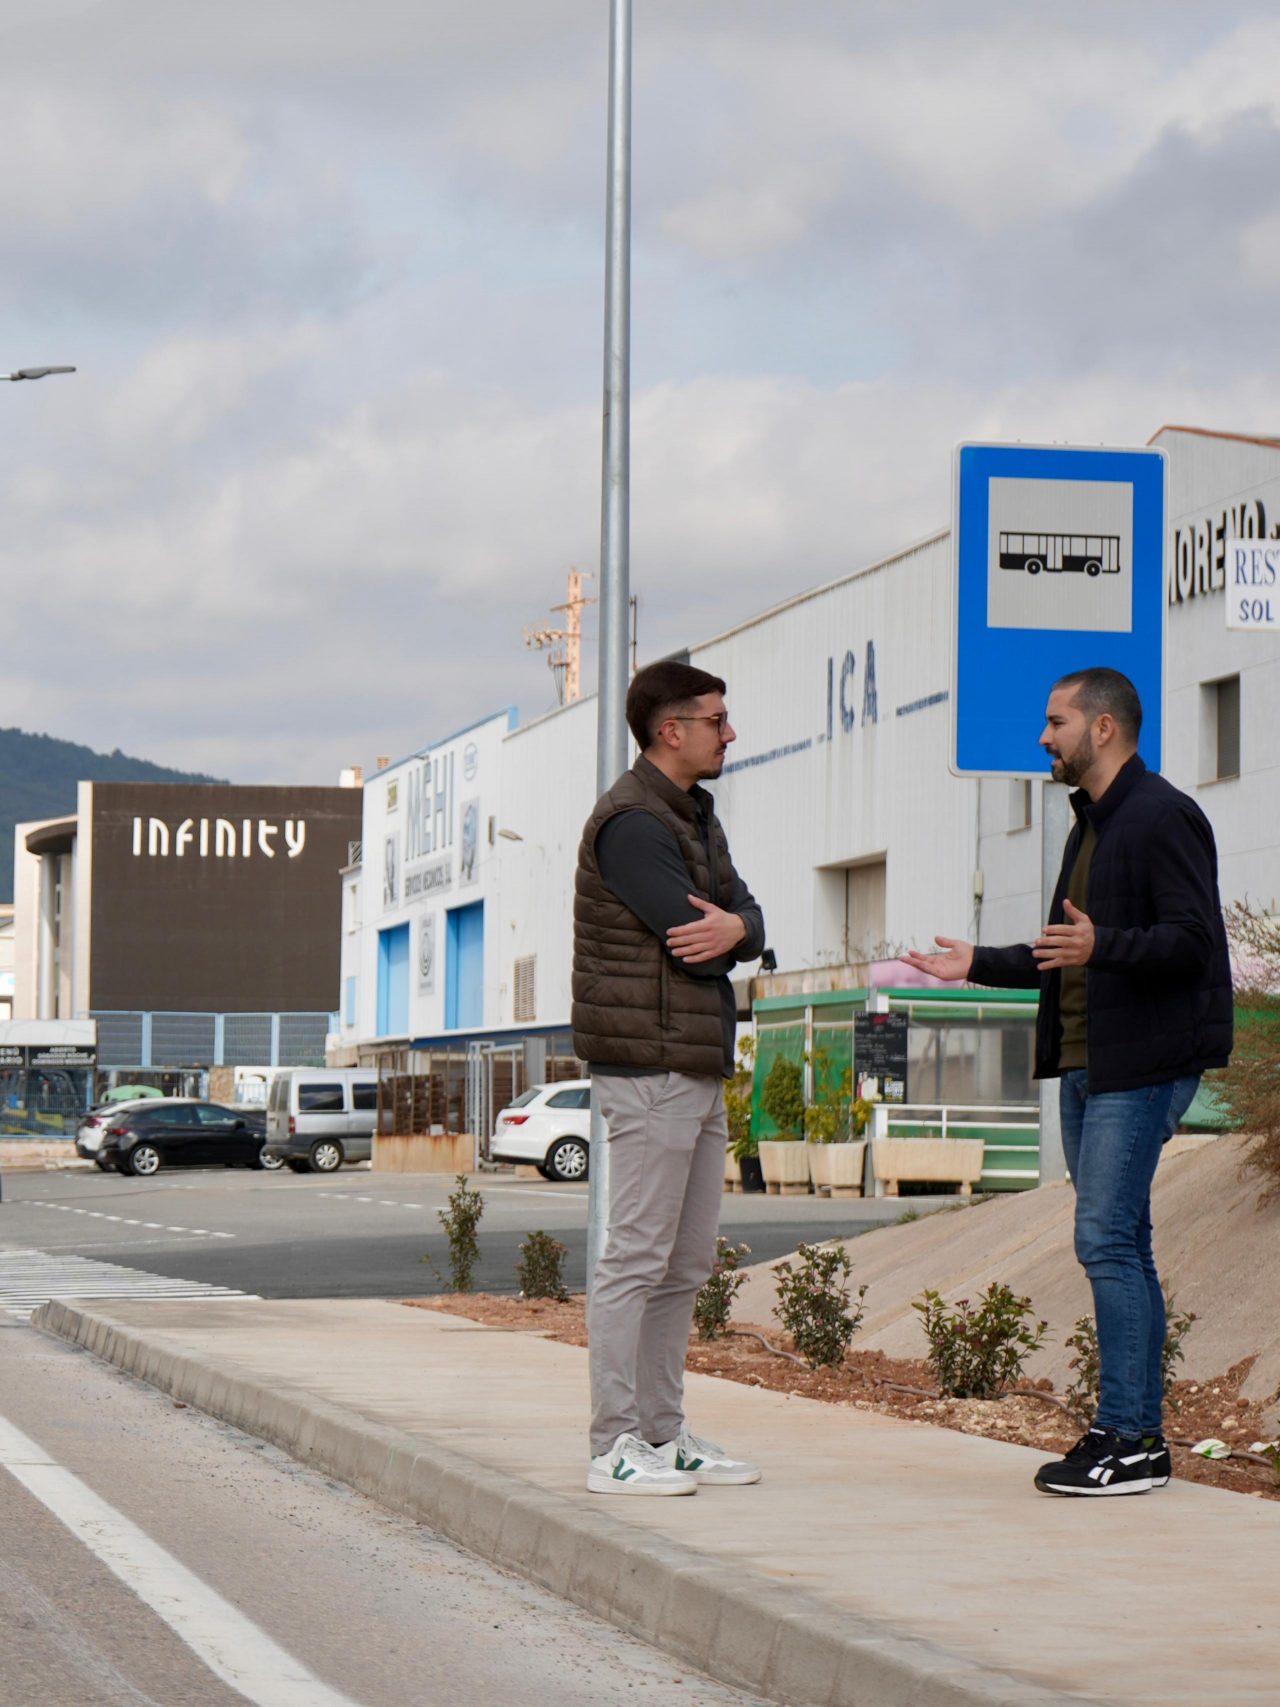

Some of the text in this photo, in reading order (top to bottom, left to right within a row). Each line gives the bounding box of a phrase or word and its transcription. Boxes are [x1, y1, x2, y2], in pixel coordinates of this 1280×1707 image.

[1234, 548, 1280, 586] RES
[1239, 598, 1274, 622] SOL
[826, 639, 878, 742] ICA
[404, 750, 455, 862] MEHI
